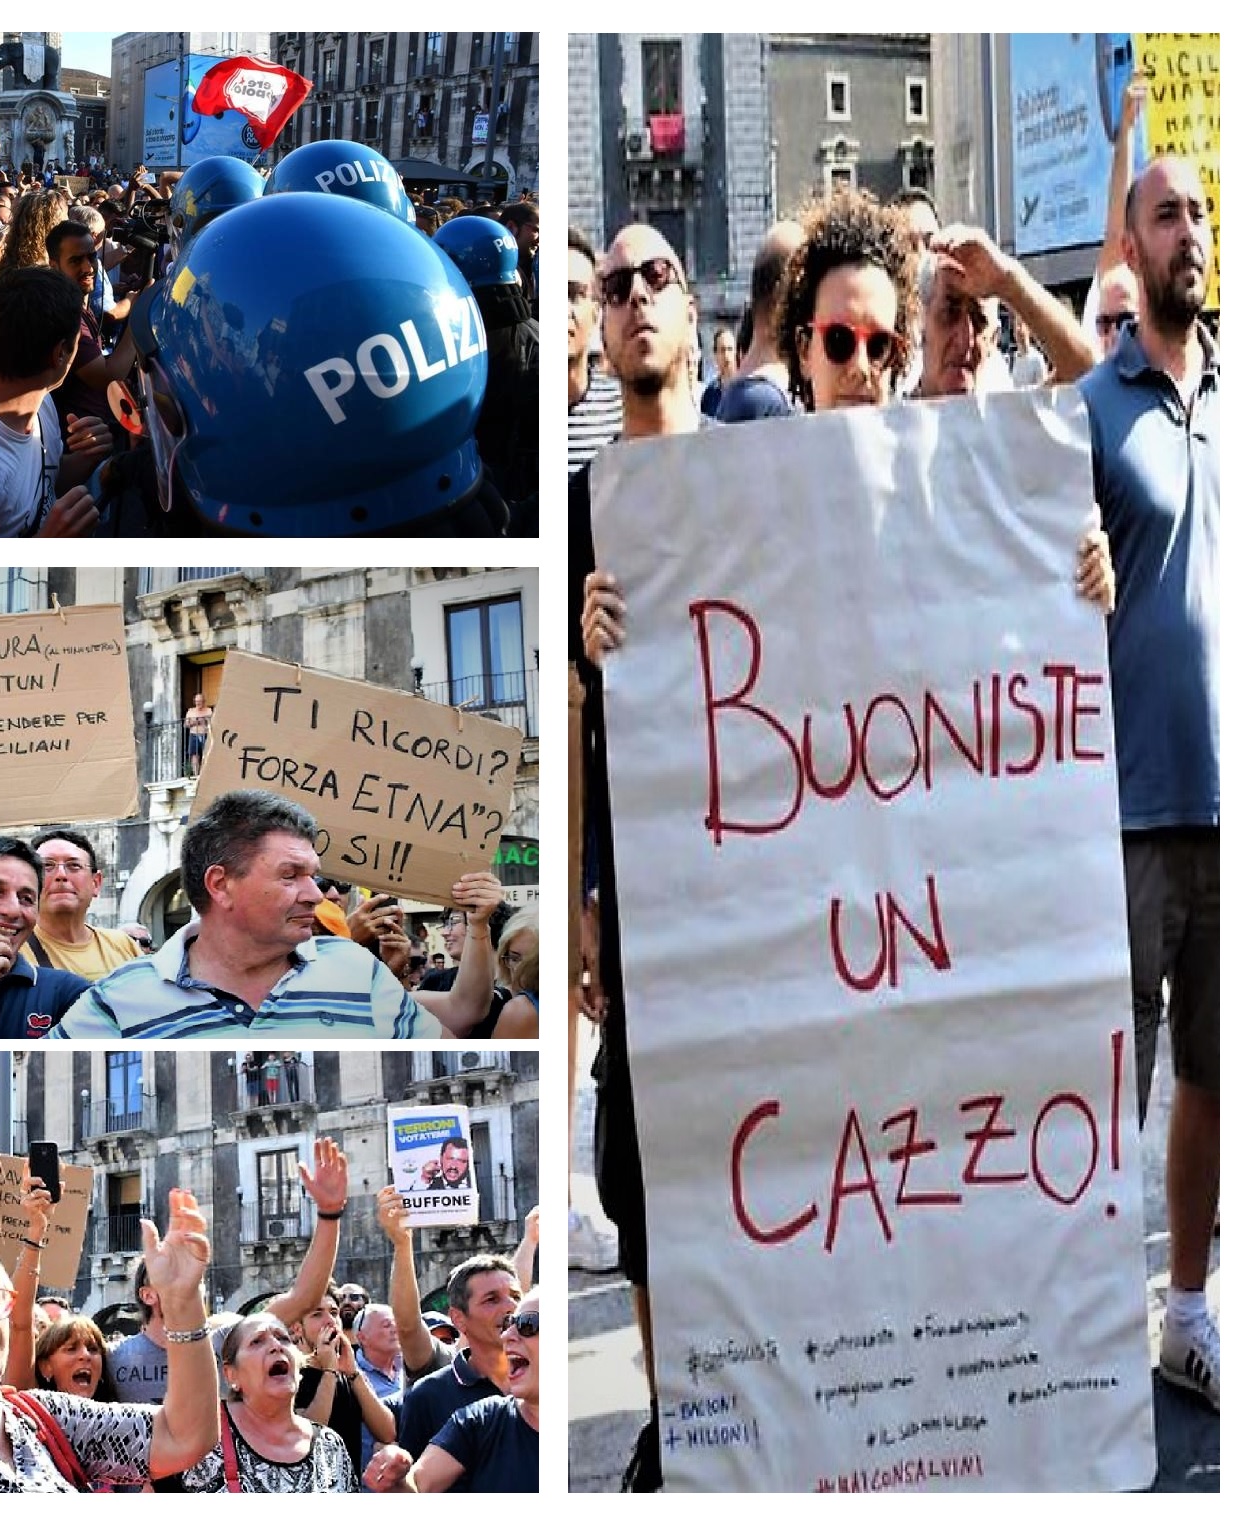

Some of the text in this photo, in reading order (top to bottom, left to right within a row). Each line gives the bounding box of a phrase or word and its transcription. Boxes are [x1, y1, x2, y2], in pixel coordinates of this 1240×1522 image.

[303, 295, 488, 425] POLIZI
[76, 711, 108, 725] PER
[264, 686, 509, 785] TI RICORDI?
[689, 599, 1105, 846] BUONISTE
[341, 835, 413, 882] SI!!
[830, 875, 952, 992] UN
[731, 1030, 1126, 1253] CAZZO!
[402, 1195, 471, 1208] BUFFONE
[116, 1364, 168, 1383] CALIF
